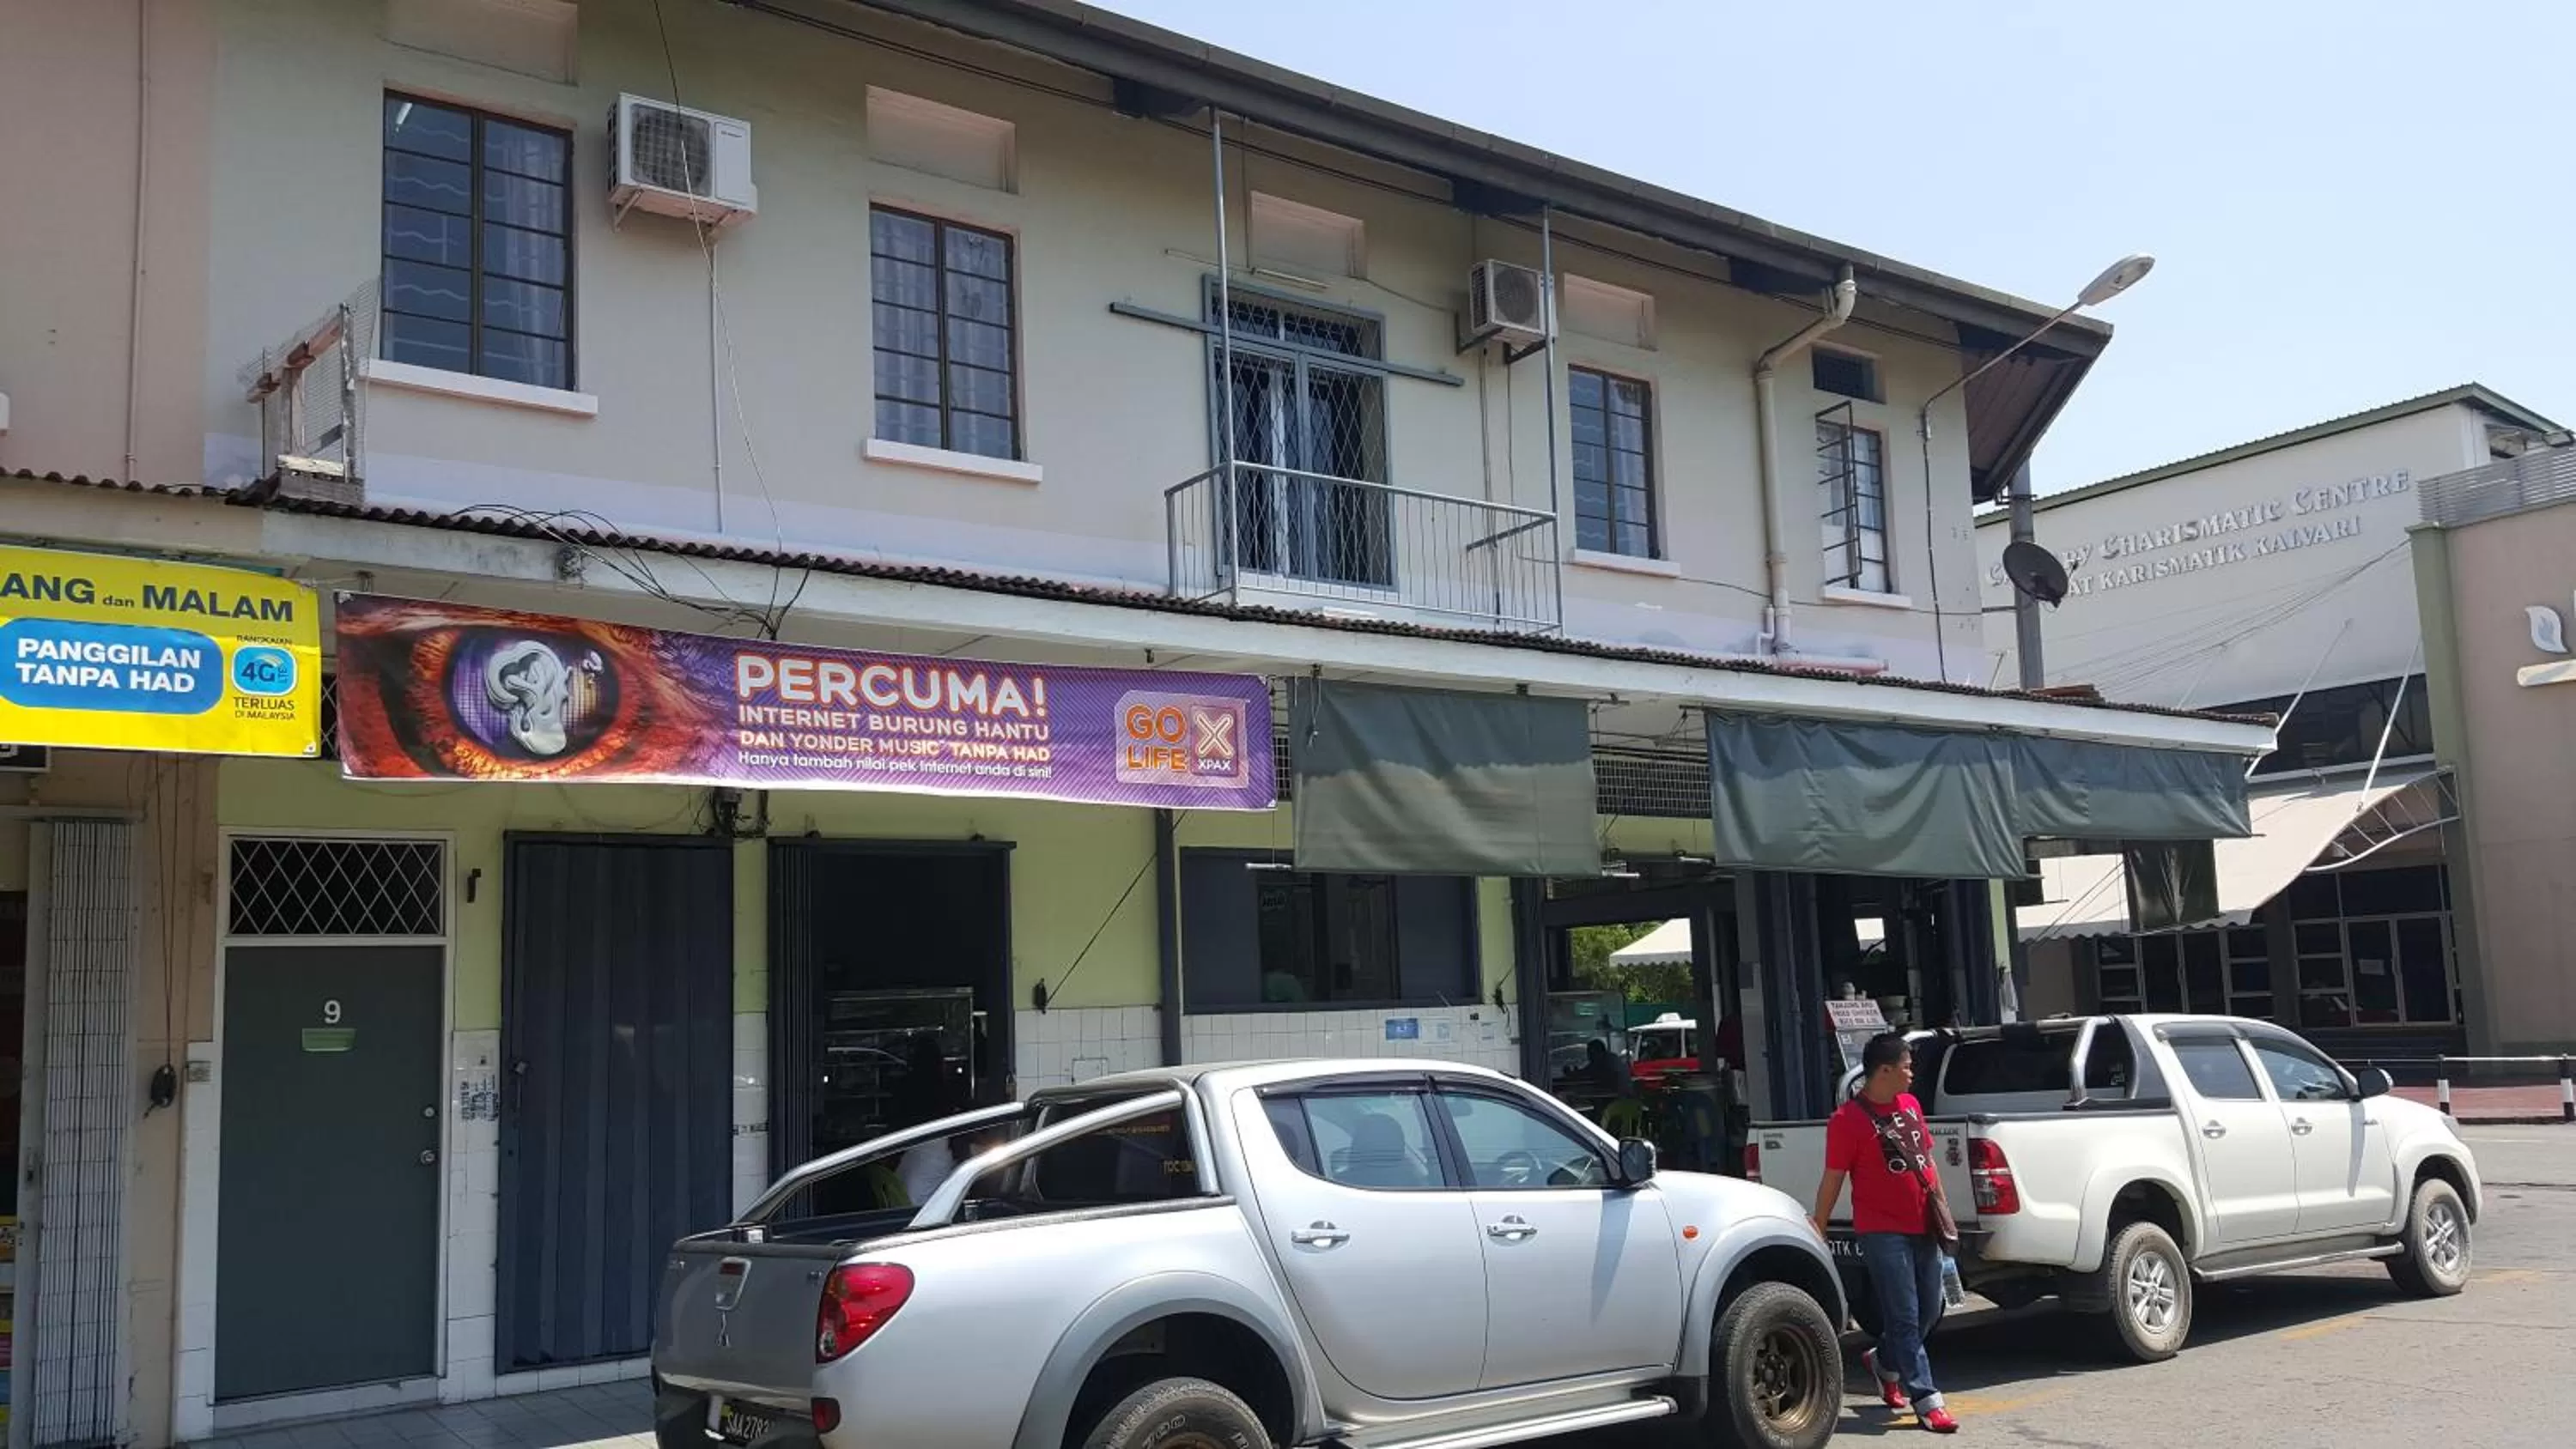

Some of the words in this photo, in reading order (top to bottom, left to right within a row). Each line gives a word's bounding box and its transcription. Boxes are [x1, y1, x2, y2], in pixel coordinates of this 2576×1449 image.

[2099, 499, 2281, 560] CHARISMATIC
[2293, 468, 2409, 516] CENTRE
[2099, 543, 2246, 591] KARISMATIK
[2256, 515, 2362, 557] KALVARI
[103, 595, 136, 609] dan
[143, 585, 294, 622] MALAM
[17, 638, 202, 670] PANGGILAN
[15, 663, 119, 689] TANPA
[130, 671, 196, 694] HAD
[241, 661, 276, 682] 4G
[737, 653, 1047, 718] PERCUMA!
[234, 696, 295, 711] TERLUAS
[247, 711, 295, 720] MALAYSIA
[738, 705, 861, 729] INTERNET
[868, 713, 968, 737] BURUNG
[975, 720, 1049, 741] HANTU
[1125, 703, 1188, 743] GO
[740, 730, 785, 748] DAN
[790, 732, 874, 754] YONDER
[950, 742, 1009, 760] TANPA
[1013, 746, 1051, 762] HAD
[1126, 743, 1188, 773] LIFE
[738, 750, 789, 767] Hanya
[793, 754, 853, 768] tambah
[857, 757, 886, 771] nilai
[890, 759, 916, 772] pek
[975, 764, 1011, 777] anda
[1014, 765, 1027, 777] di
[1198, 758, 1232, 771] XPAX
[324, 999, 341, 1024] 9
